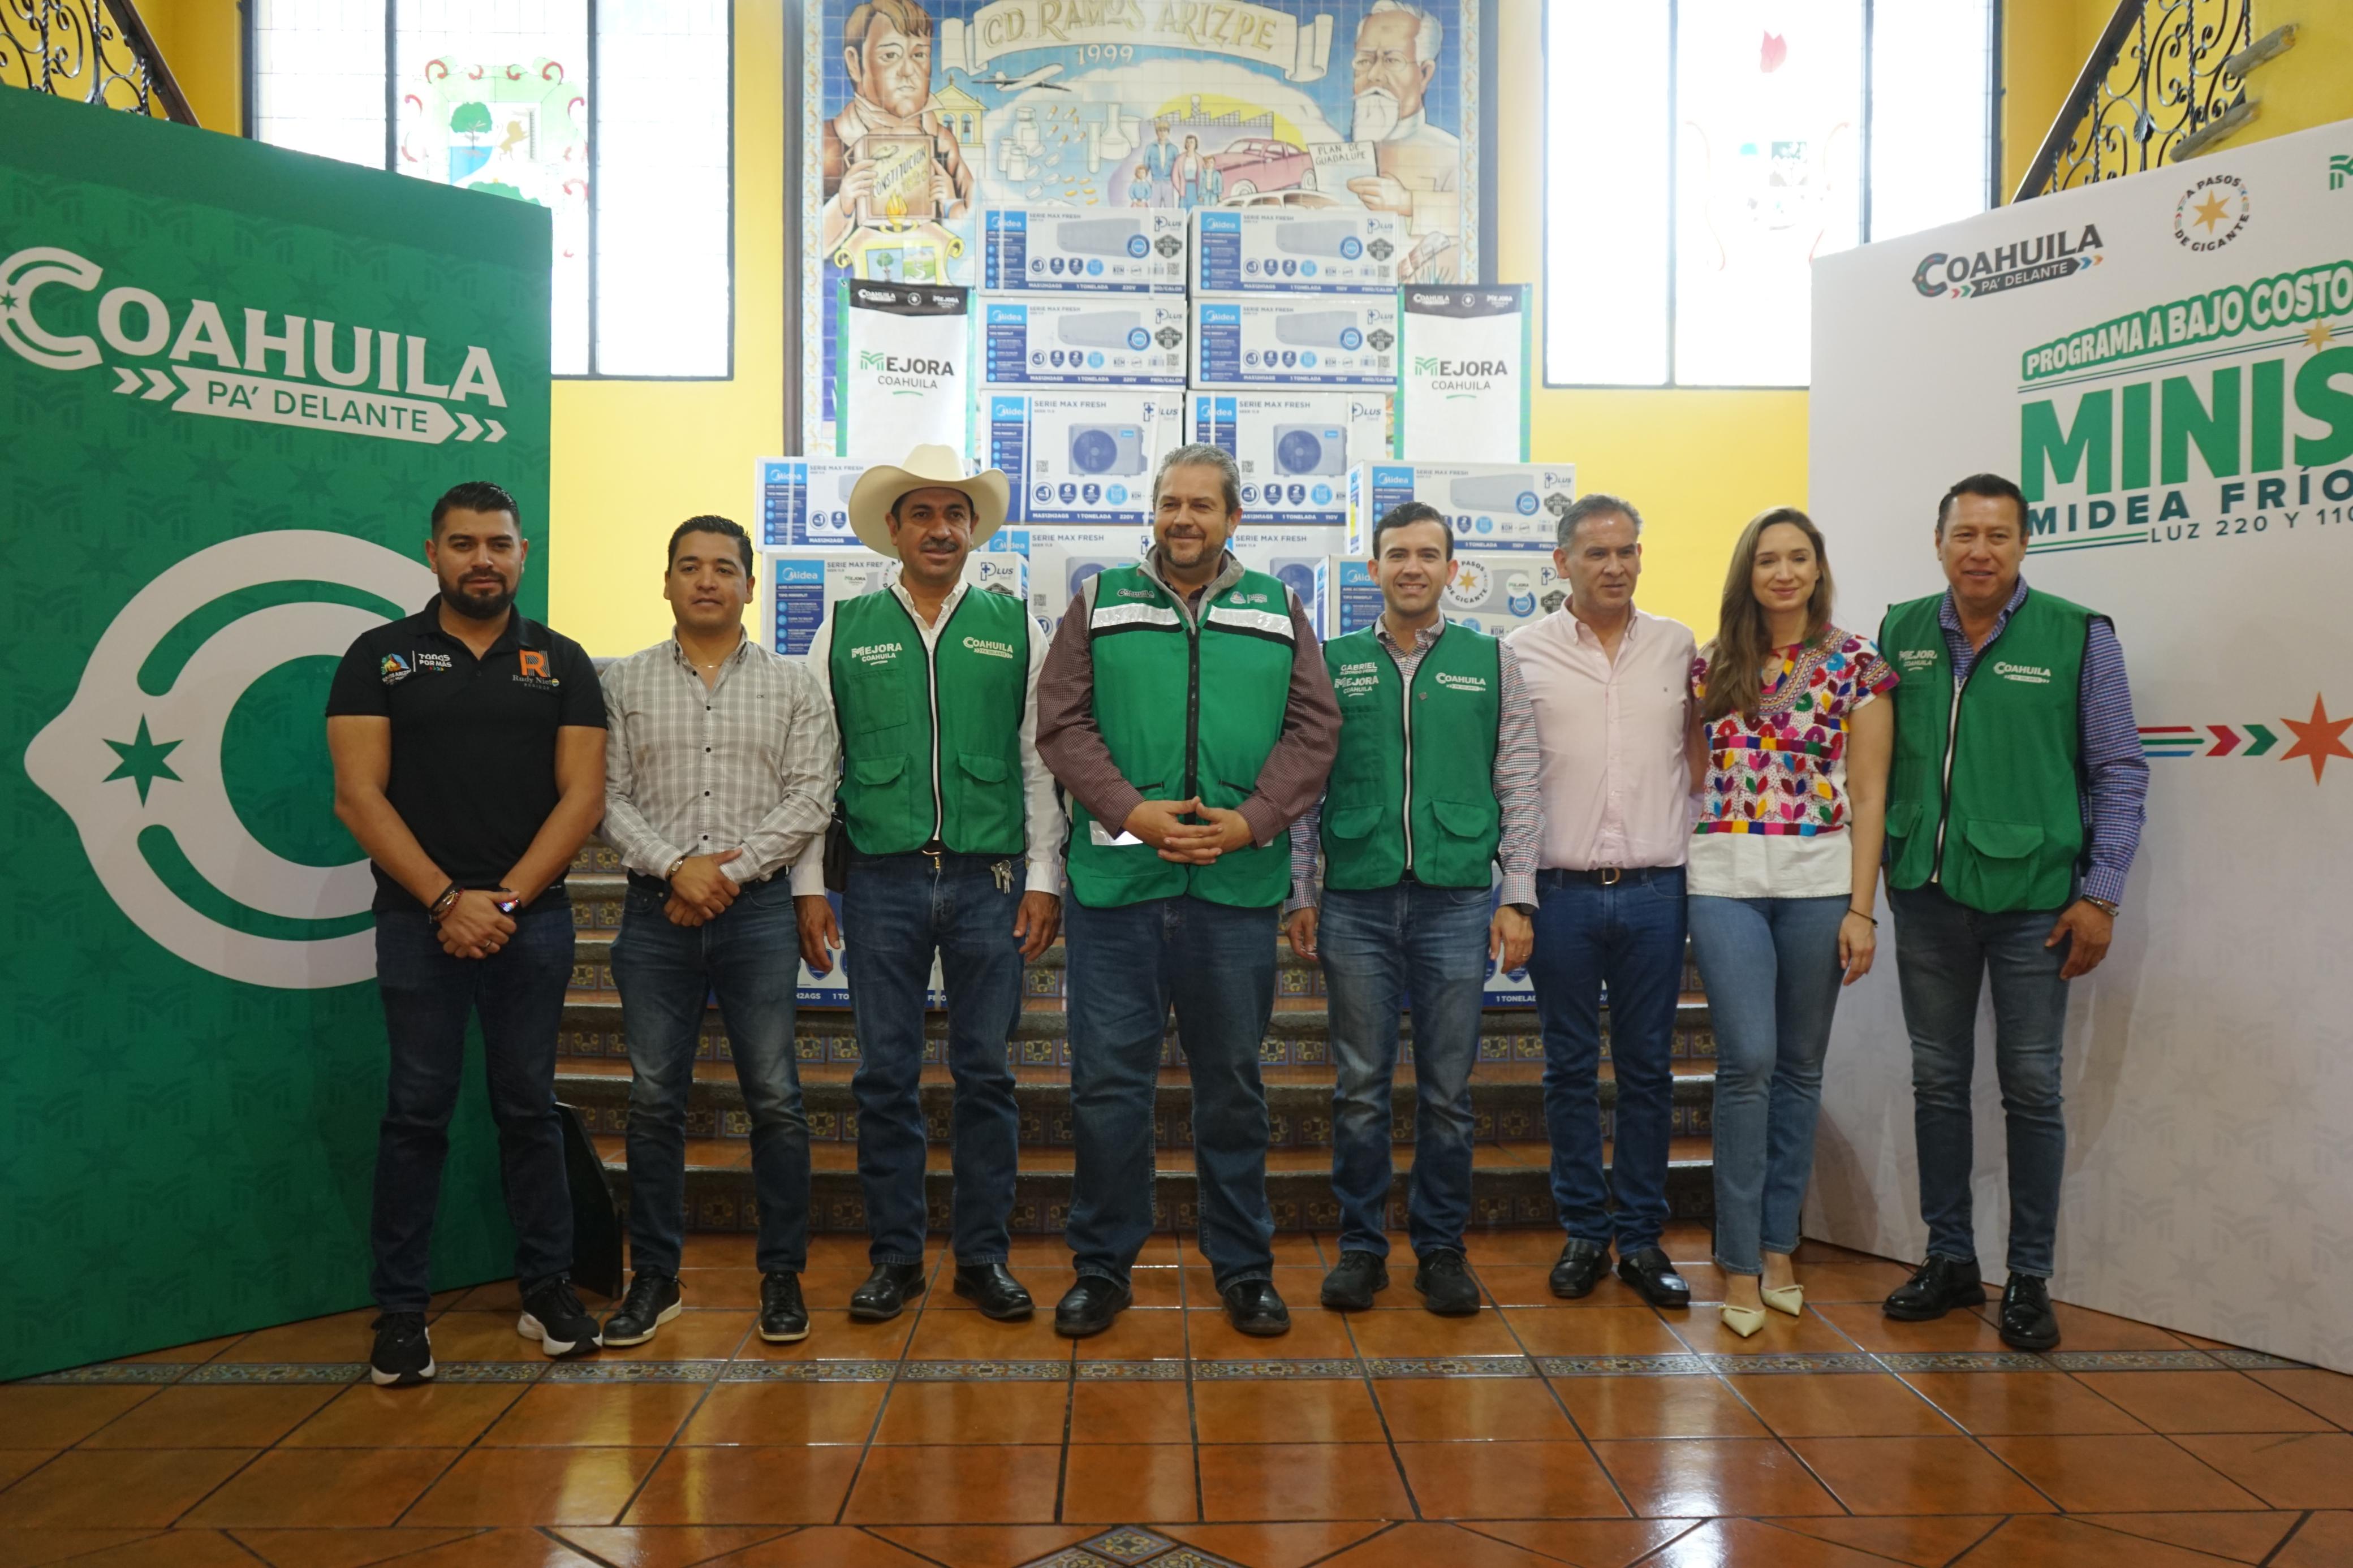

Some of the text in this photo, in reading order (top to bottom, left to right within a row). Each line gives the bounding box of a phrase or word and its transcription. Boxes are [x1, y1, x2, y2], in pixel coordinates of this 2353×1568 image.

[983, 7, 1031, 48] CD.
[1153, 0, 1277, 51] ARIZPE
[1078, 45, 1134, 65] 1999
[1318, 145, 1341, 155] PLAN
[1316, 151, 1365, 165] GUADALUPE
[2187, 175, 2241, 199] A PASOS
[992, 217, 1021, 227] idea
[1206, 218, 1235, 230] Midea
[2175, 214, 2249, 251] DE GIGANTE
[1912, 223, 2104, 298] COAHUILA
[2005, 262, 2068, 286] DELANTE
[992, 310, 1022, 321] Midea
[1206, 310, 1235, 321] Midea
[2027, 267, 2353, 377] PROGRAMA A BAJO COSTO
[0, 247, 507, 408] COAHUILA
[861, 351, 954, 375] MEJORA
[1415, 357, 1507, 375] MEJORA
[878, 376, 937, 388] COAHUILA
[1432, 381, 1490, 390] COAHUILA
[274, 390, 428, 433] DELANTE
[1201, 405, 1232, 417] Mdea
[1378, 473, 1408, 484] Midea
[2028, 467, 2353, 535] MIDEA FRÍO
[2151, 506, 2353, 543] LUZ 220 Y 110
[1462, 561, 1485, 572] PASOS
[782, 567, 818, 581] Midea
[1347, 570, 1372, 582] Mid
[1455, 589, 1488, 603] GIGANTE
[851, 643, 902, 658] MEJORA
[963, 637, 1013, 653] COAHUILA
[862, 653, 896, 662] COAHUILA
[1341, 662, 1378, 672] GABRIEL
[1993, 662, 2050, 676] COAHUILA
[512, 674, 534, 684] Rudy
[1334, 676, 1379, 689] MEJORA
[1436, 673, 1485, 685] COAHUILA
